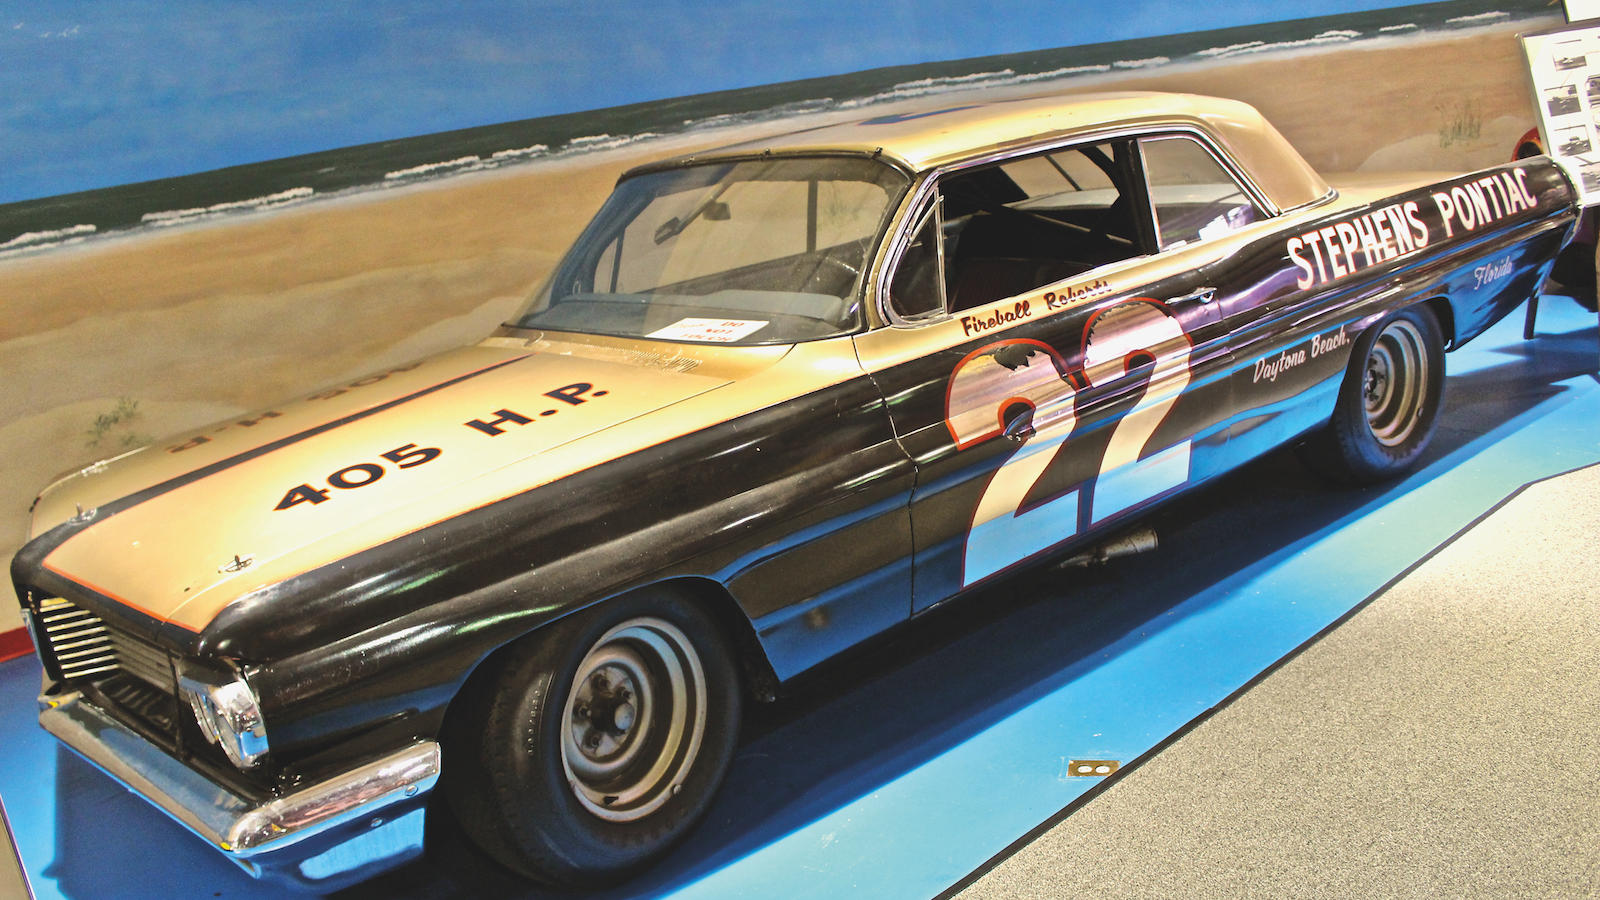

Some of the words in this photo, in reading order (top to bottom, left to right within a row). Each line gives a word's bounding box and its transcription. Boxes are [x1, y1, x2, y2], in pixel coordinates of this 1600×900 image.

[1286, 201, 1429, 291] STEPHENS
[1432, 167, 1538, 238] PONTIAC
[1474, 255, 1513, 290] Florida
[960, 300, 1032, 337] Fireball
[1043, 280, 1113, 311] Roberts
[1252, 349, 1307, 384] Daytona
[272, 443, 443, 512] 405
[462, 382, 610, 438] H.P.
[944, 297, 1194, 592] 22
